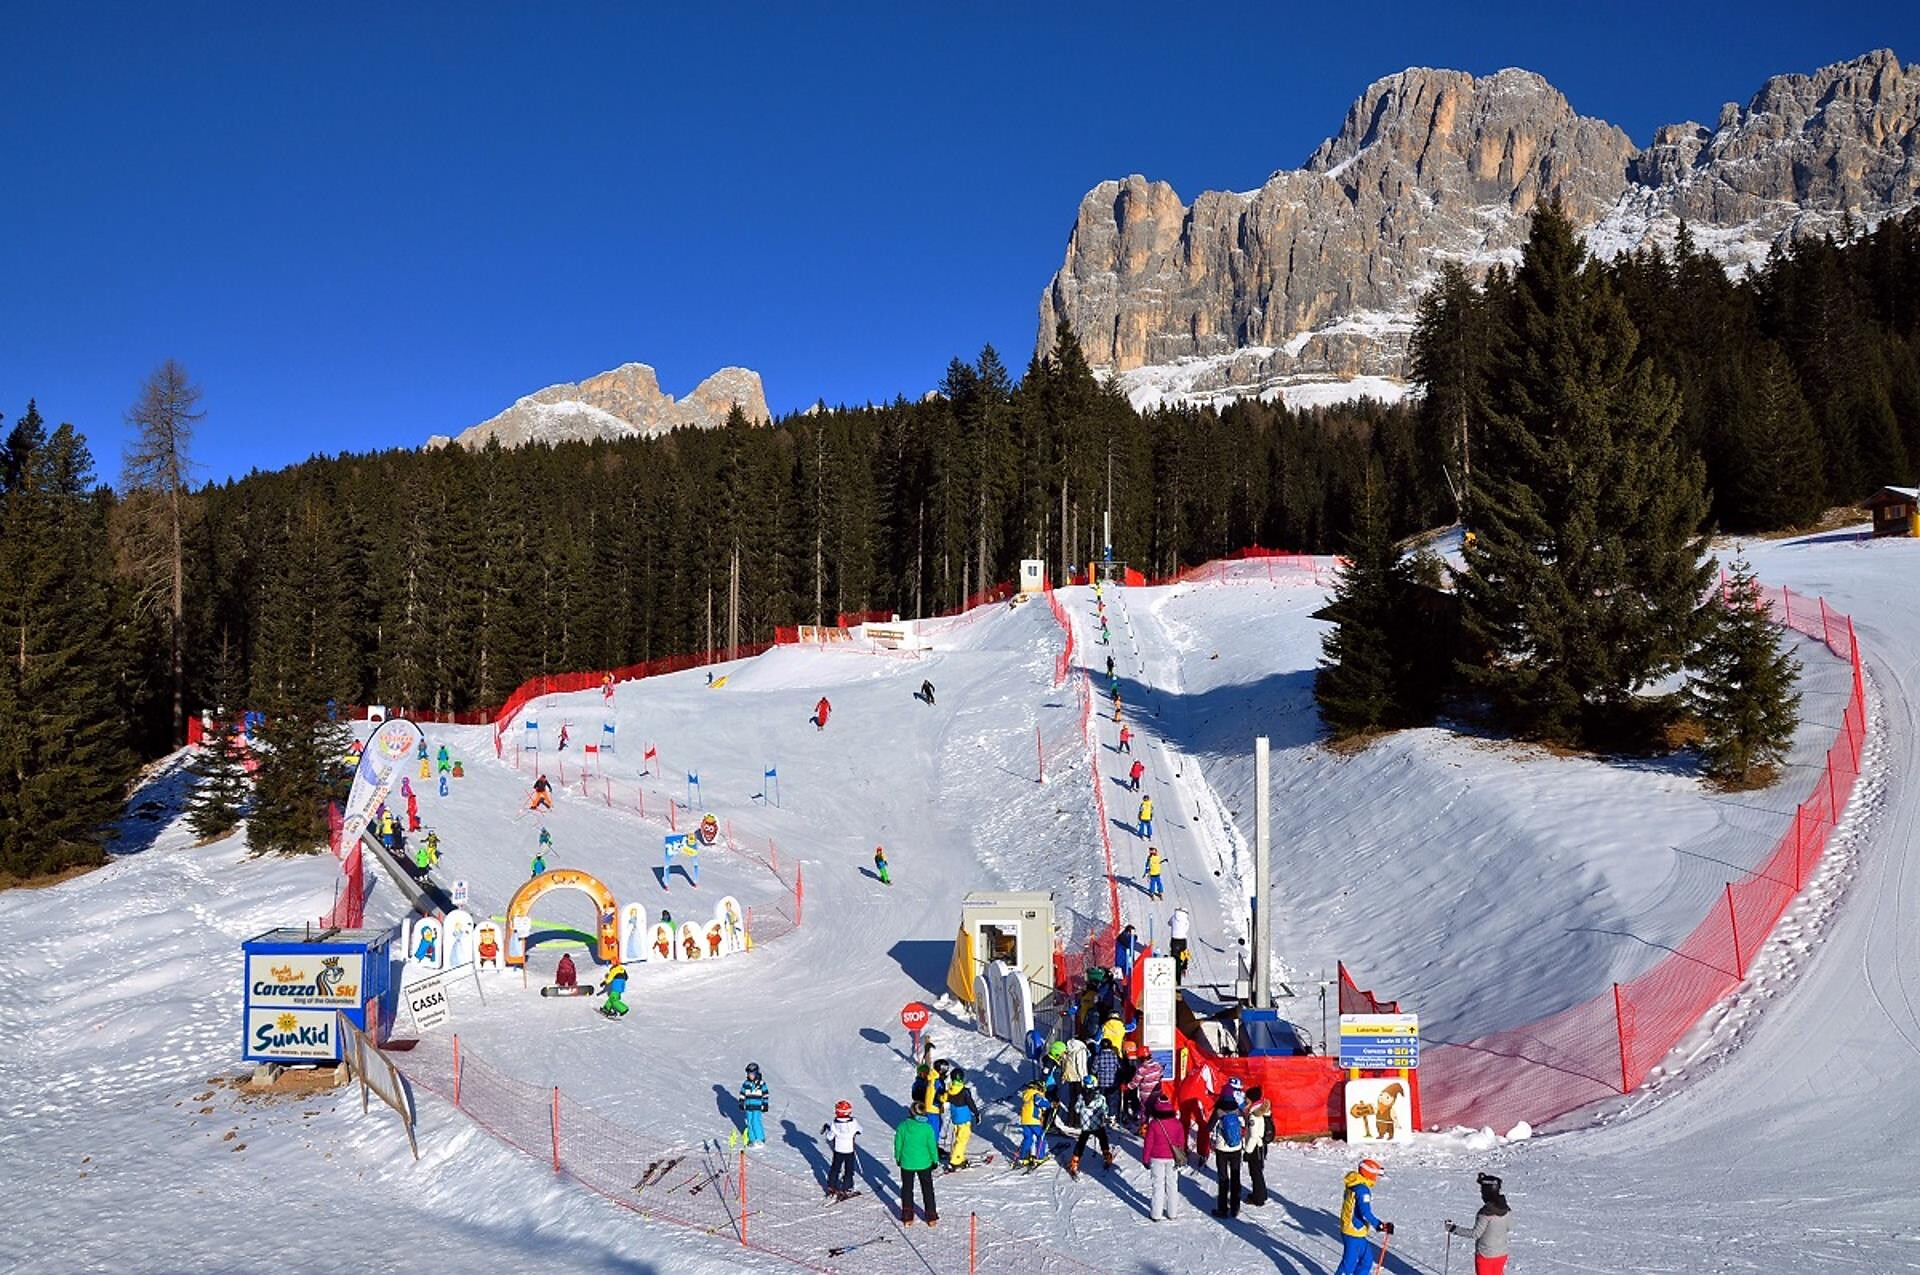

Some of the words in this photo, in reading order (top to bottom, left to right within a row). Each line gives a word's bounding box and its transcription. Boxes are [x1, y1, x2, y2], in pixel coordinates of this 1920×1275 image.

[253, 982, 316, 997] Carezza
[336, 985, 358, 997] Ski
[412, 991, 445, 1012] CASSA
[904, 1010, 926, 1023] STOP
